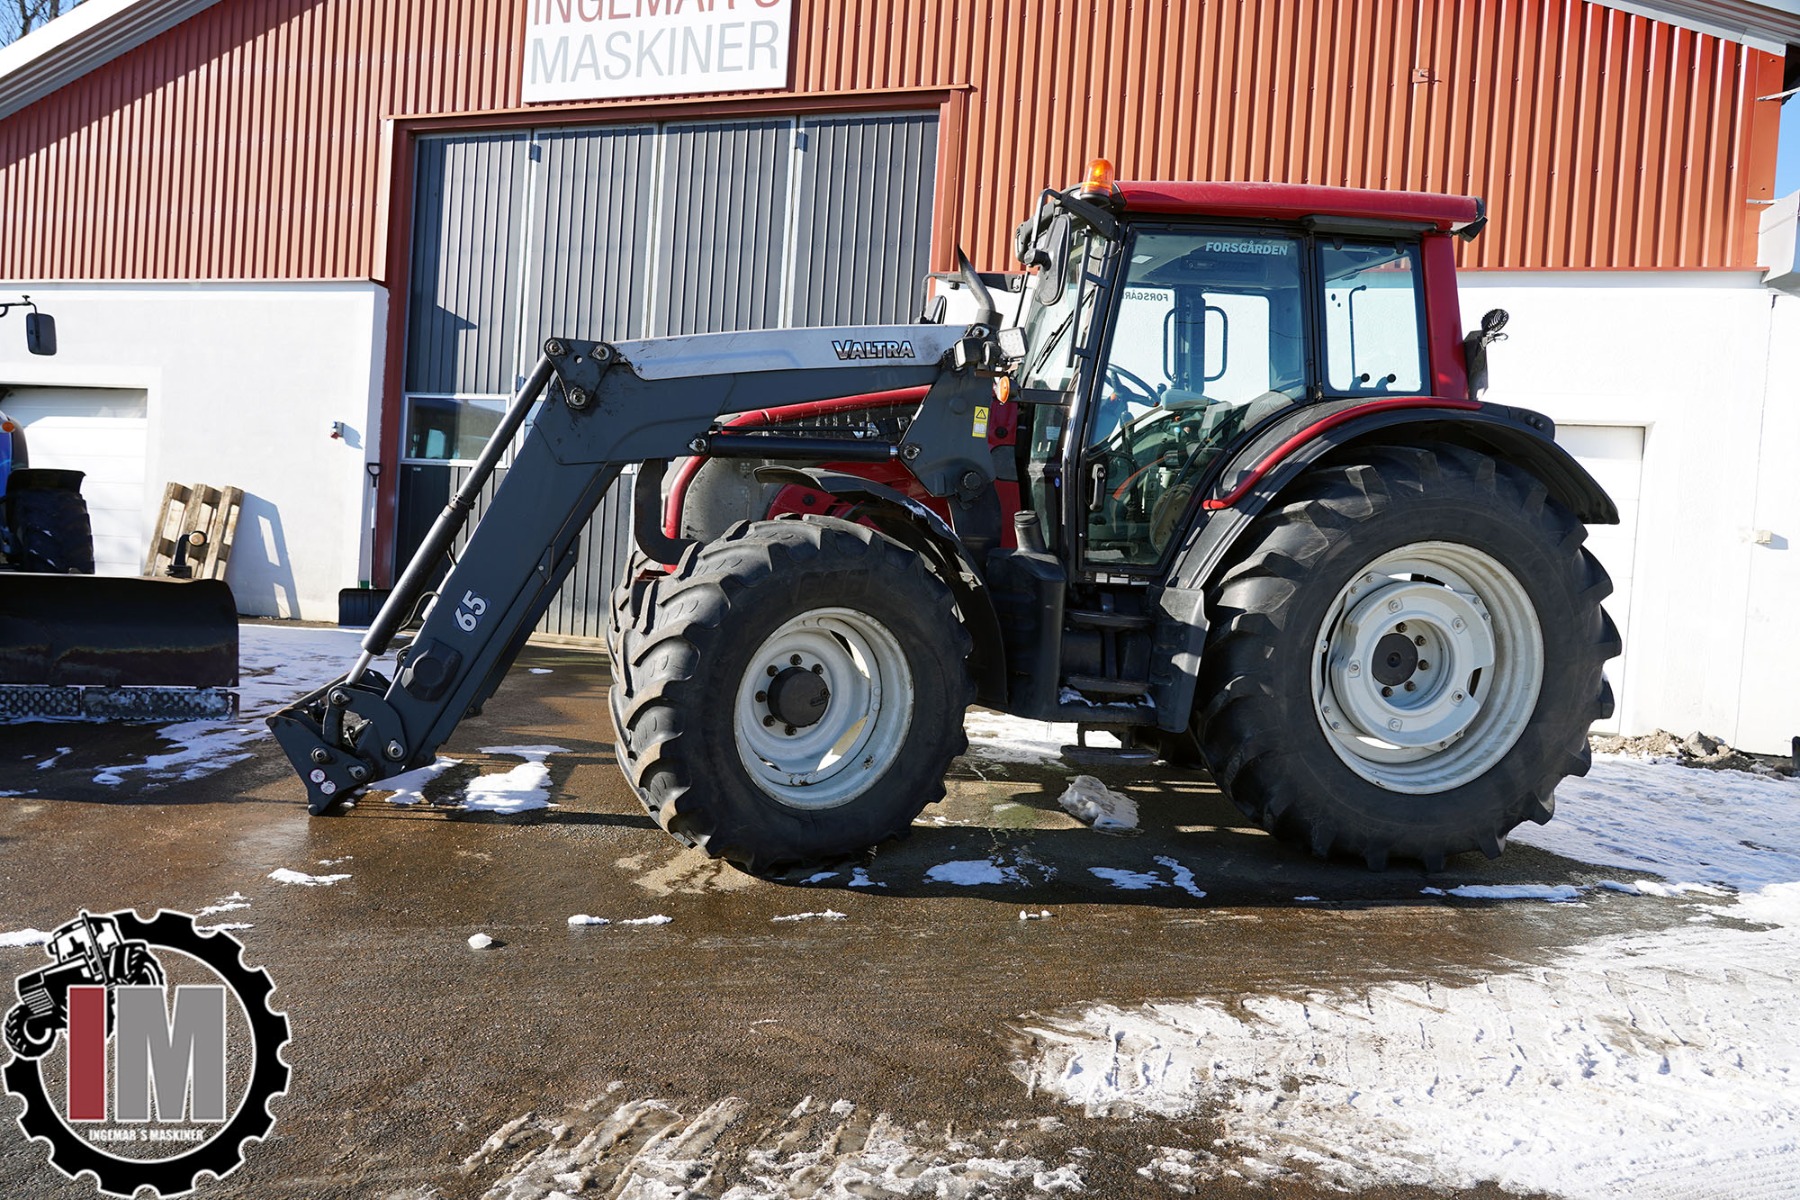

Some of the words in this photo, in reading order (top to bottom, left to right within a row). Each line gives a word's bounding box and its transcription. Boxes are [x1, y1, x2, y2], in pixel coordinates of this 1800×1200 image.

[530, 20, 779, 84] MASKINER
[1205, 240, 1288, 256] FORSGÅRDEN
[832, 340, 915, 360] VALTRA
[455, 589, 487, 632] 65
